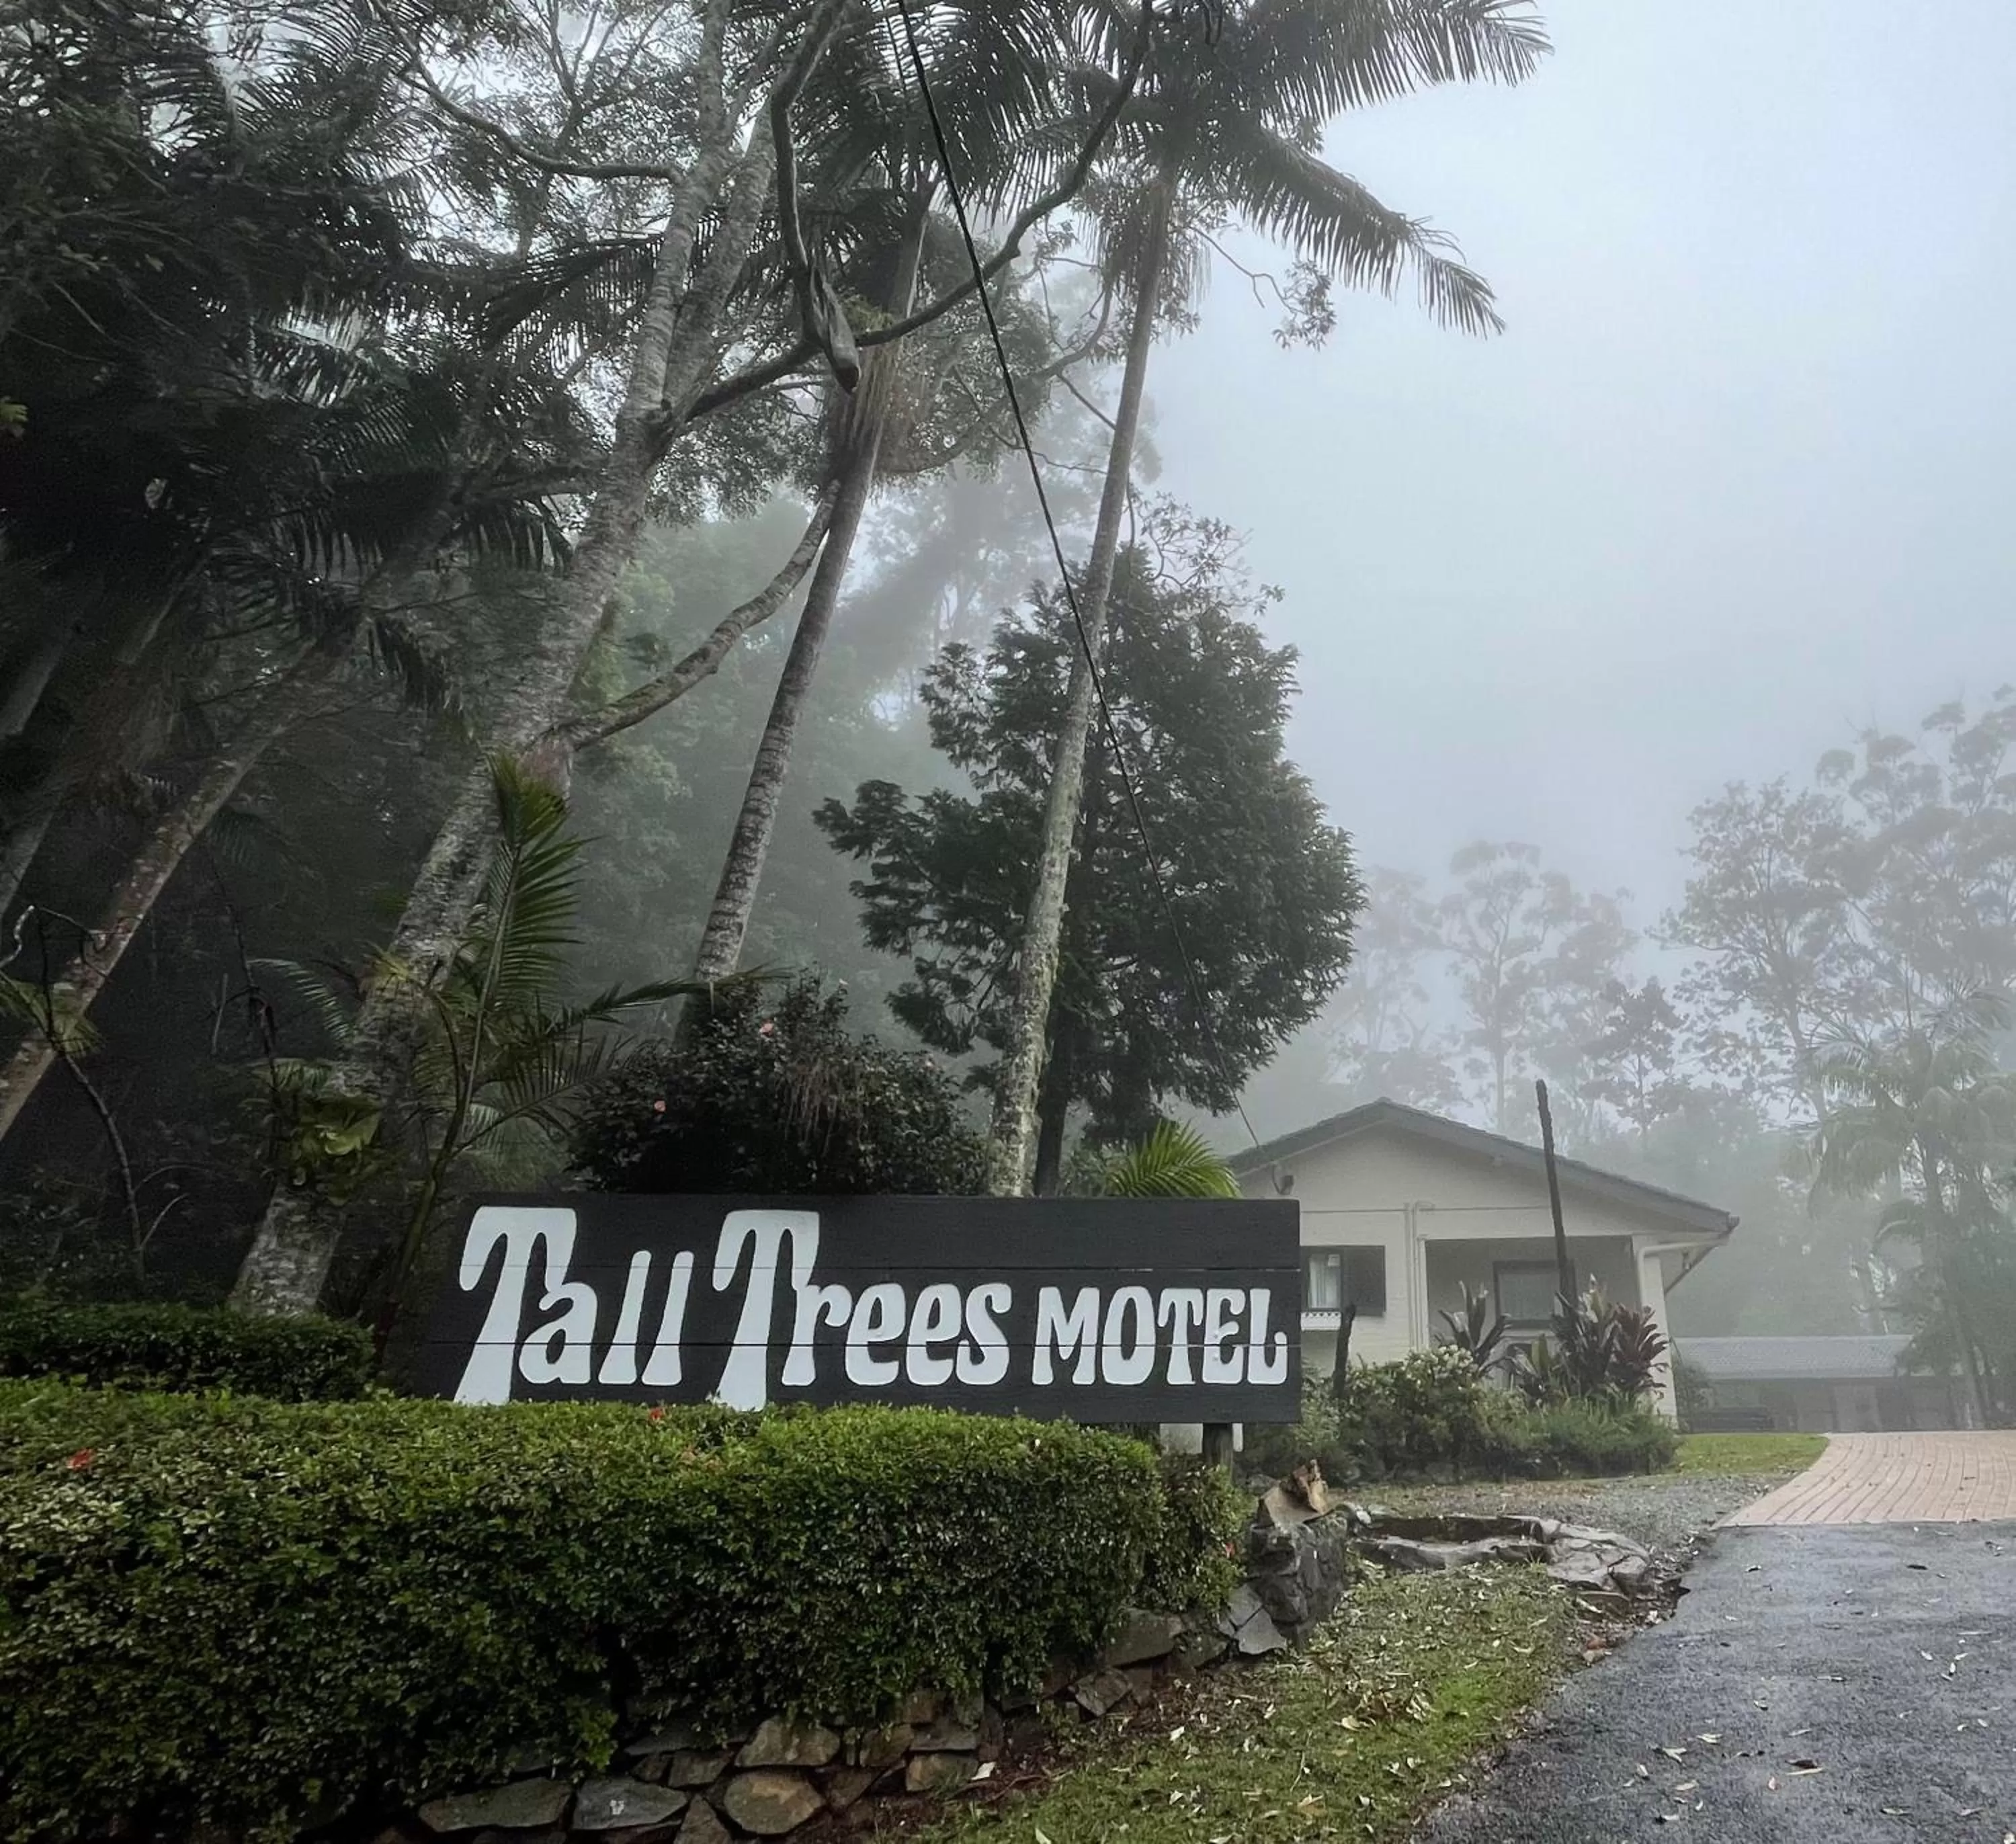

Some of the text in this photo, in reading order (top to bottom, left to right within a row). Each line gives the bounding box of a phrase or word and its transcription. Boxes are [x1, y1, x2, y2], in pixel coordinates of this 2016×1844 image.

[454, 1206, 1288, 1411] Tall Trees MOTEL
